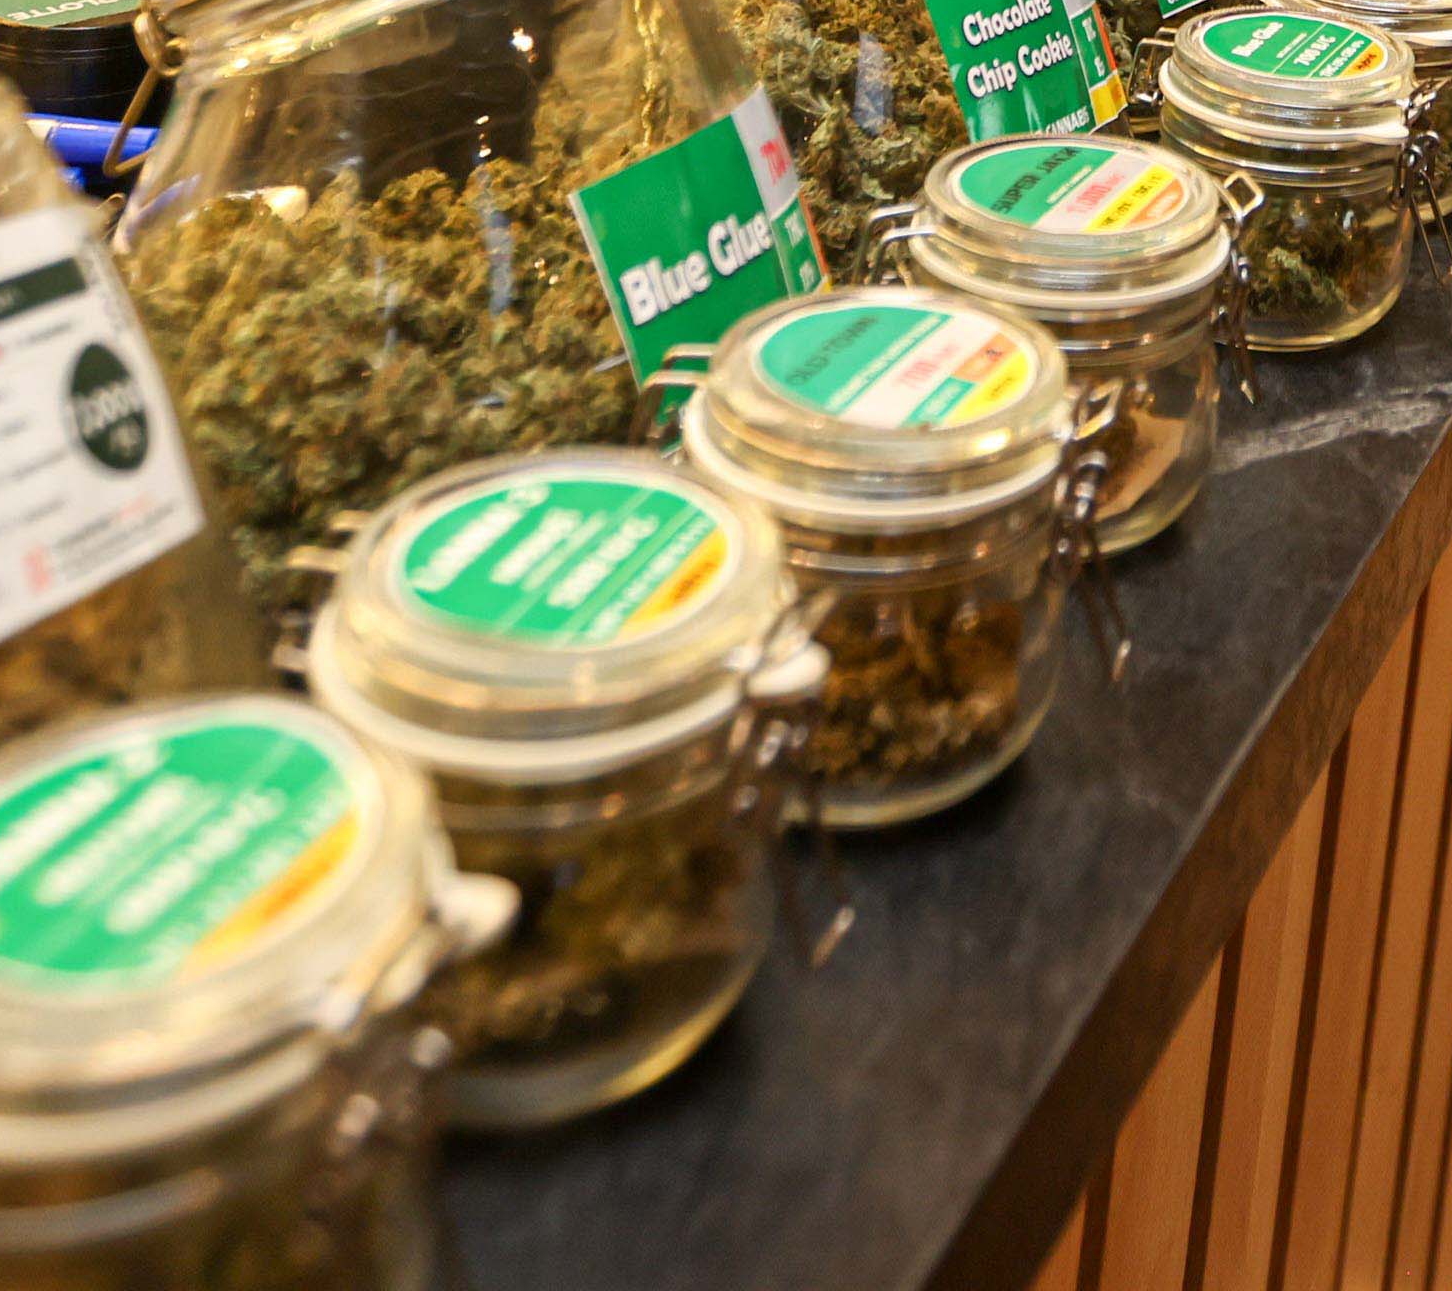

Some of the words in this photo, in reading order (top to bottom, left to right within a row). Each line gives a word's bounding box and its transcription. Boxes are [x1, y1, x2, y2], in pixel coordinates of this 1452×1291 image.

[966, 58, 1018, 99] Chip
[1016, 31, 1074, 77] Cookie
[1293, 48, 1322, 67] 700
[990, 173, 1042, 215] SUPER
[618, 250, 712, 327] Blue
[707, 213, 776, 277] Glue
